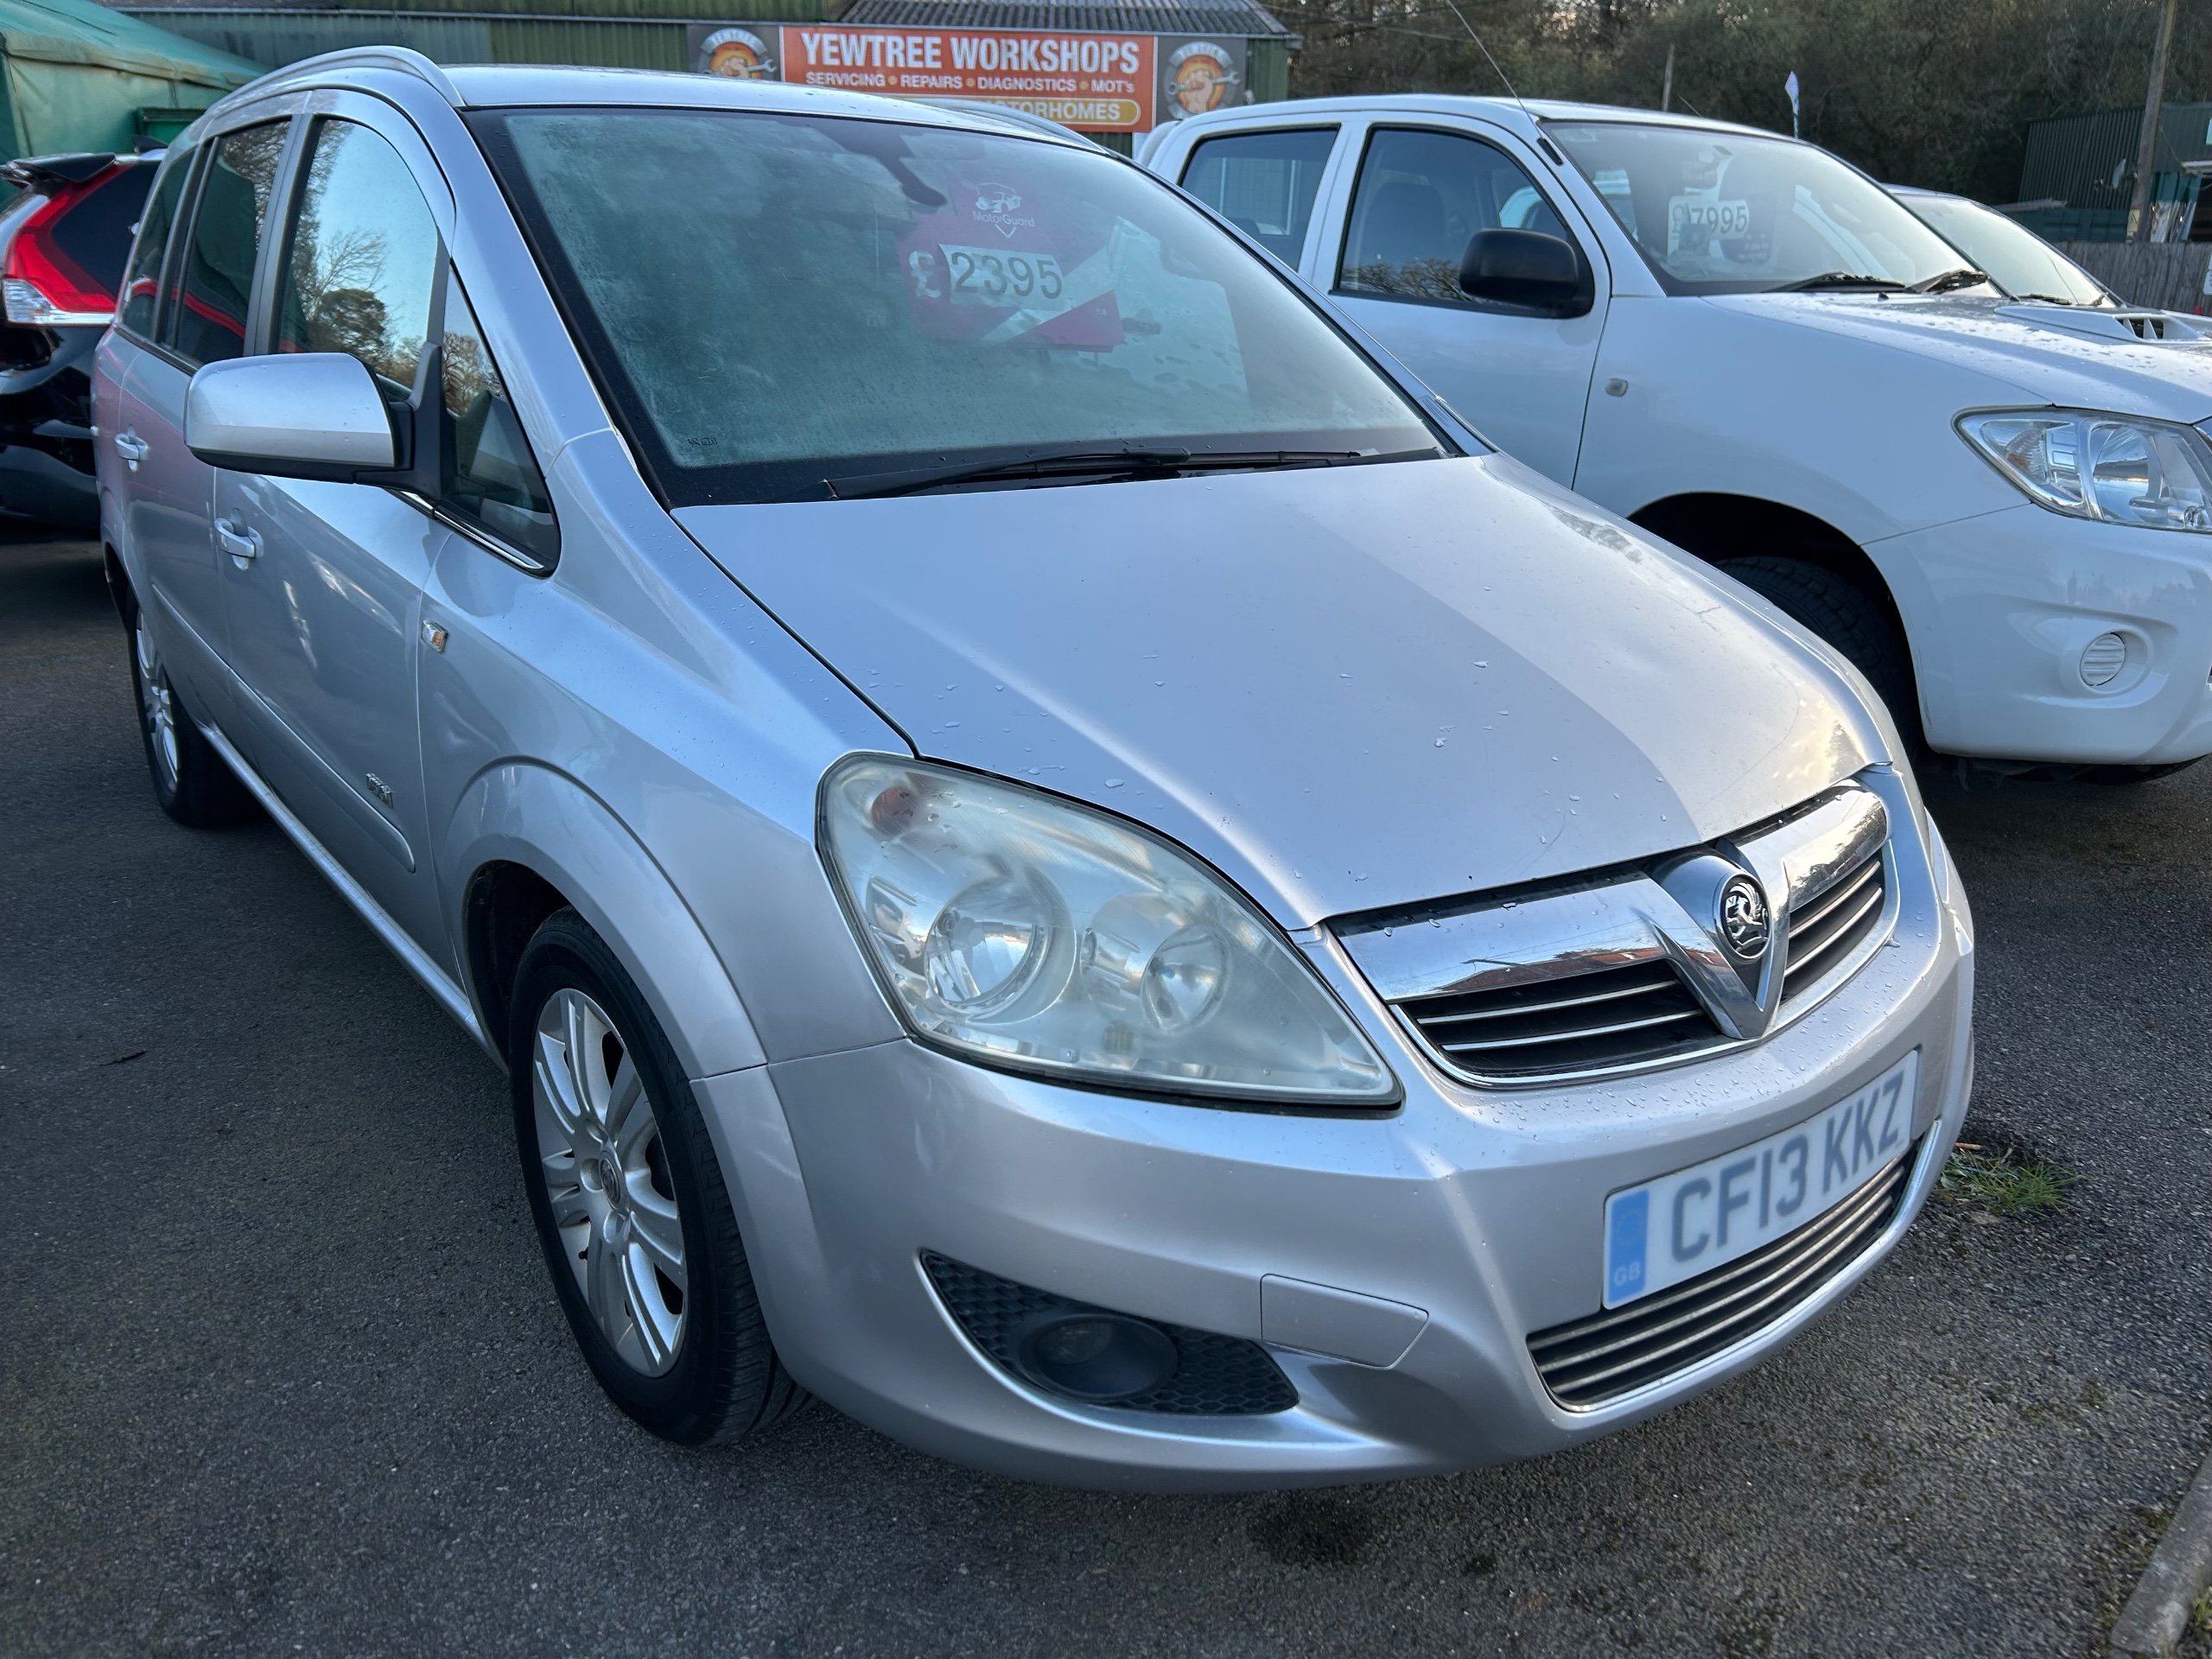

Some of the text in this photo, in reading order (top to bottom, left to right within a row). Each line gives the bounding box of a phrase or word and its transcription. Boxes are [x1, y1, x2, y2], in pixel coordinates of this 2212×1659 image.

[801, 32, 1140, 74] YEWTREE WORKSHOPS
[806, 72, 886, 86] SERVICING
[900, 74, 963, 89] REPAIRS
[977, 77, 1077, 92] DIAGNOSTICS
[972, 211, 1036, 226] MotorGuard
[1671, 1071, 1904, 1263] CF13 KKZ
[1614, 1261, 1641, 1286] GB
